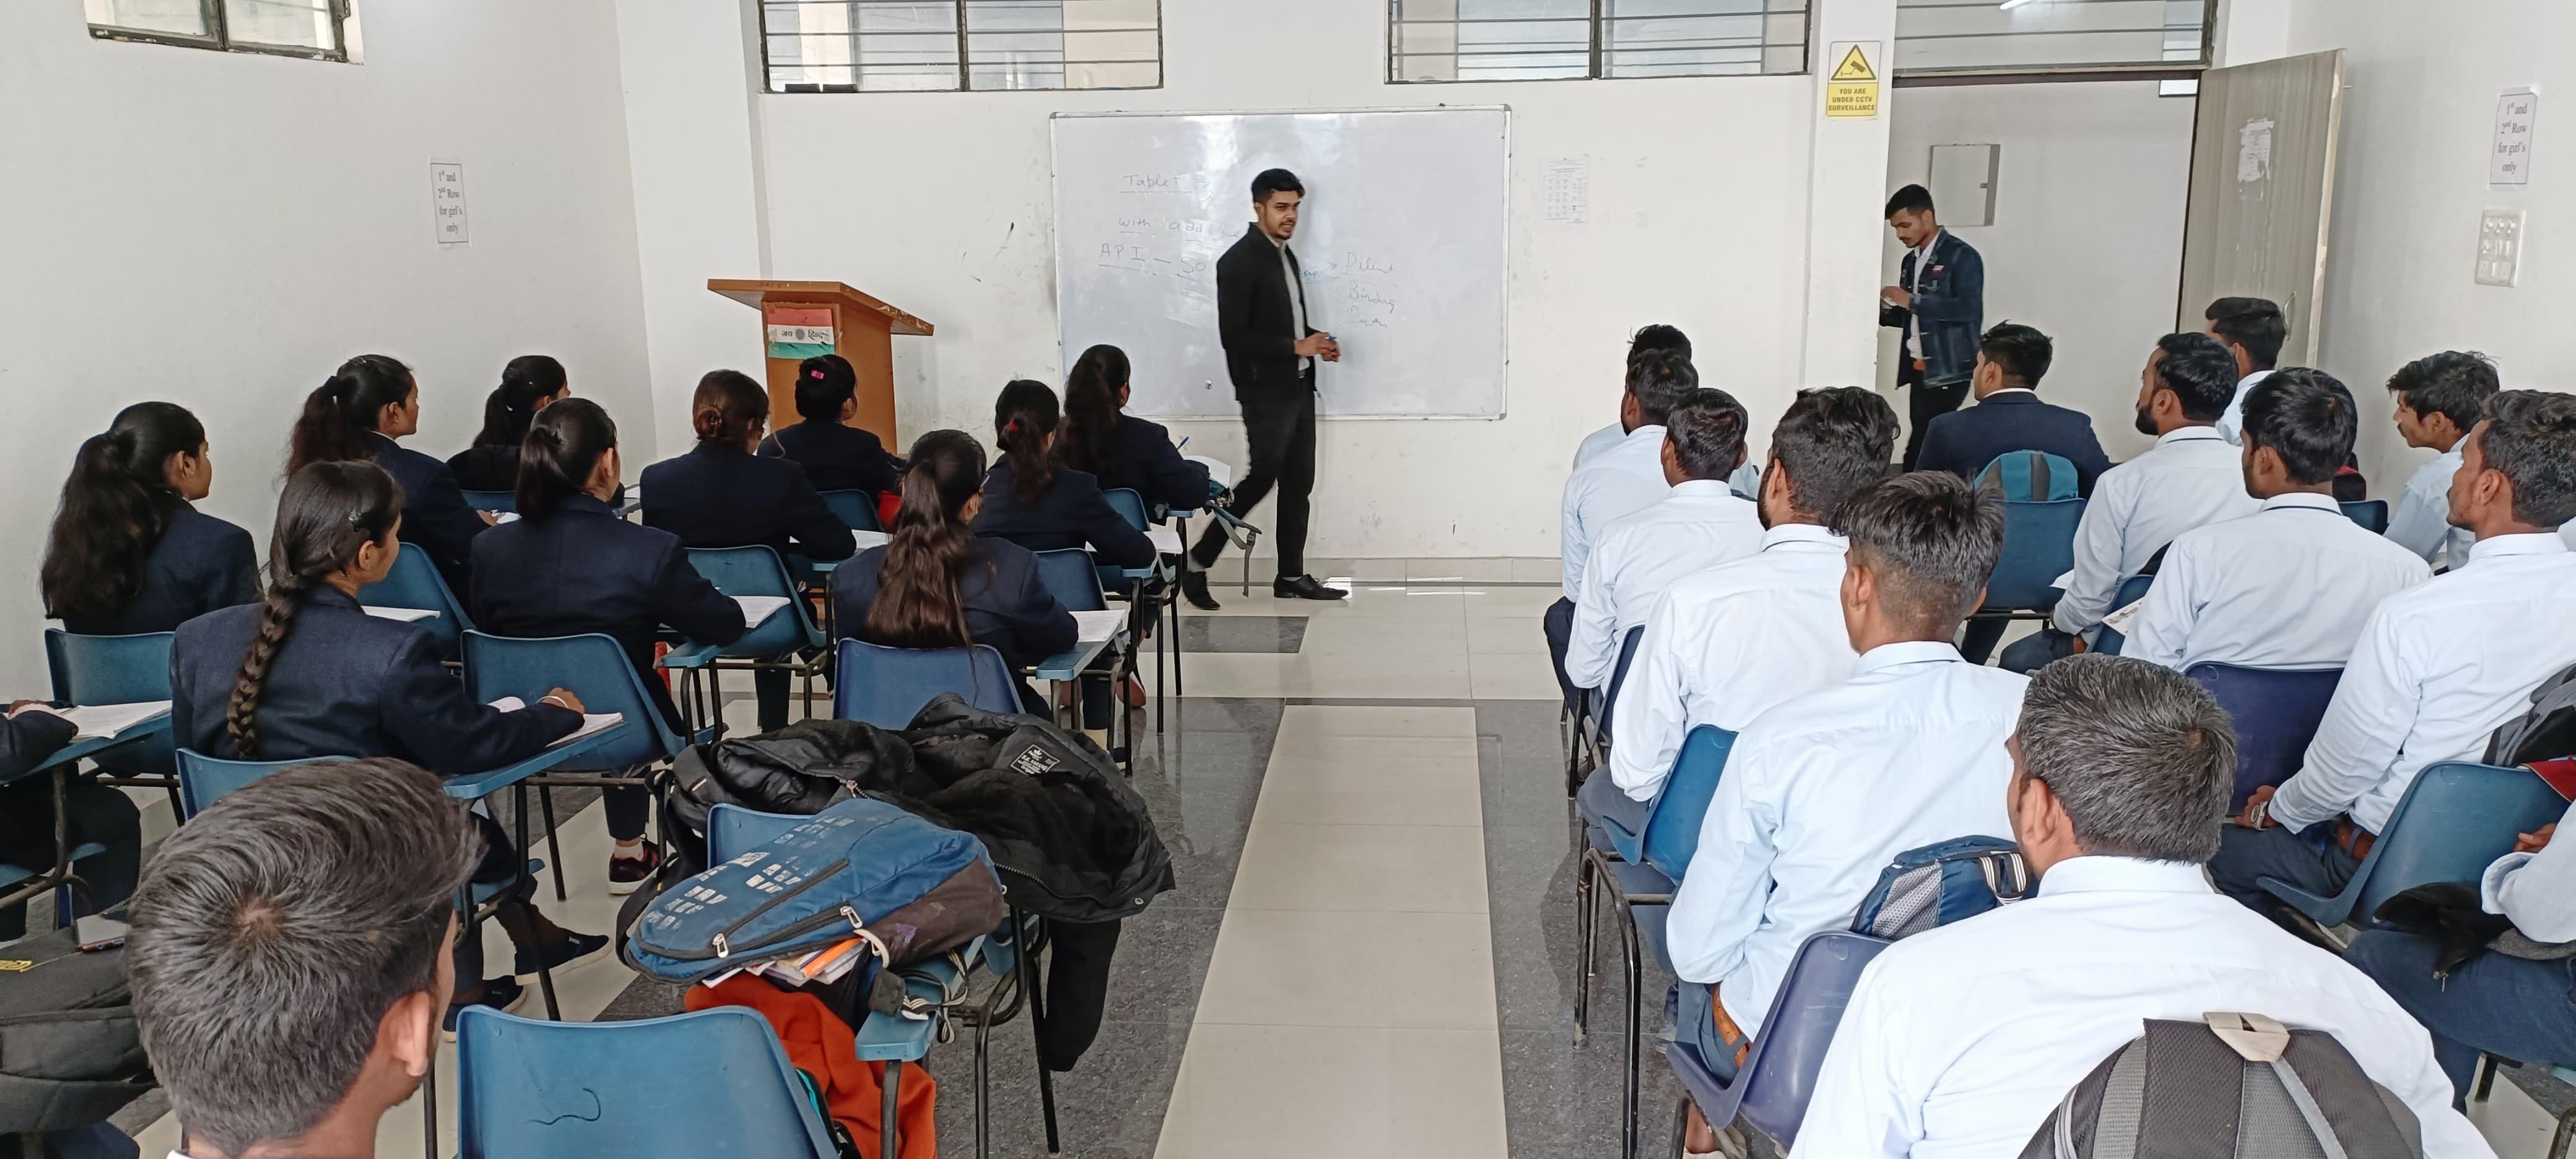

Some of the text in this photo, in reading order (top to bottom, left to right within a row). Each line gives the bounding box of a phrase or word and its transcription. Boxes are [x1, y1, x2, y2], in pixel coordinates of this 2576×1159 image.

[2515, 103, 2528, 115] and
[2512, 123, 2527, 134] Row
[2498, 142, 2508, 154] for
[2502, 161, 2517, 175] only
[446, 172, 456, 182] and
[447, 188, 459, 198] Row
[439, 205, 447, 216] for
[446, 223, 458, 234] only
[1100, 243, 1145, 262] API
[807, 329, 824, 340] हिन्द
